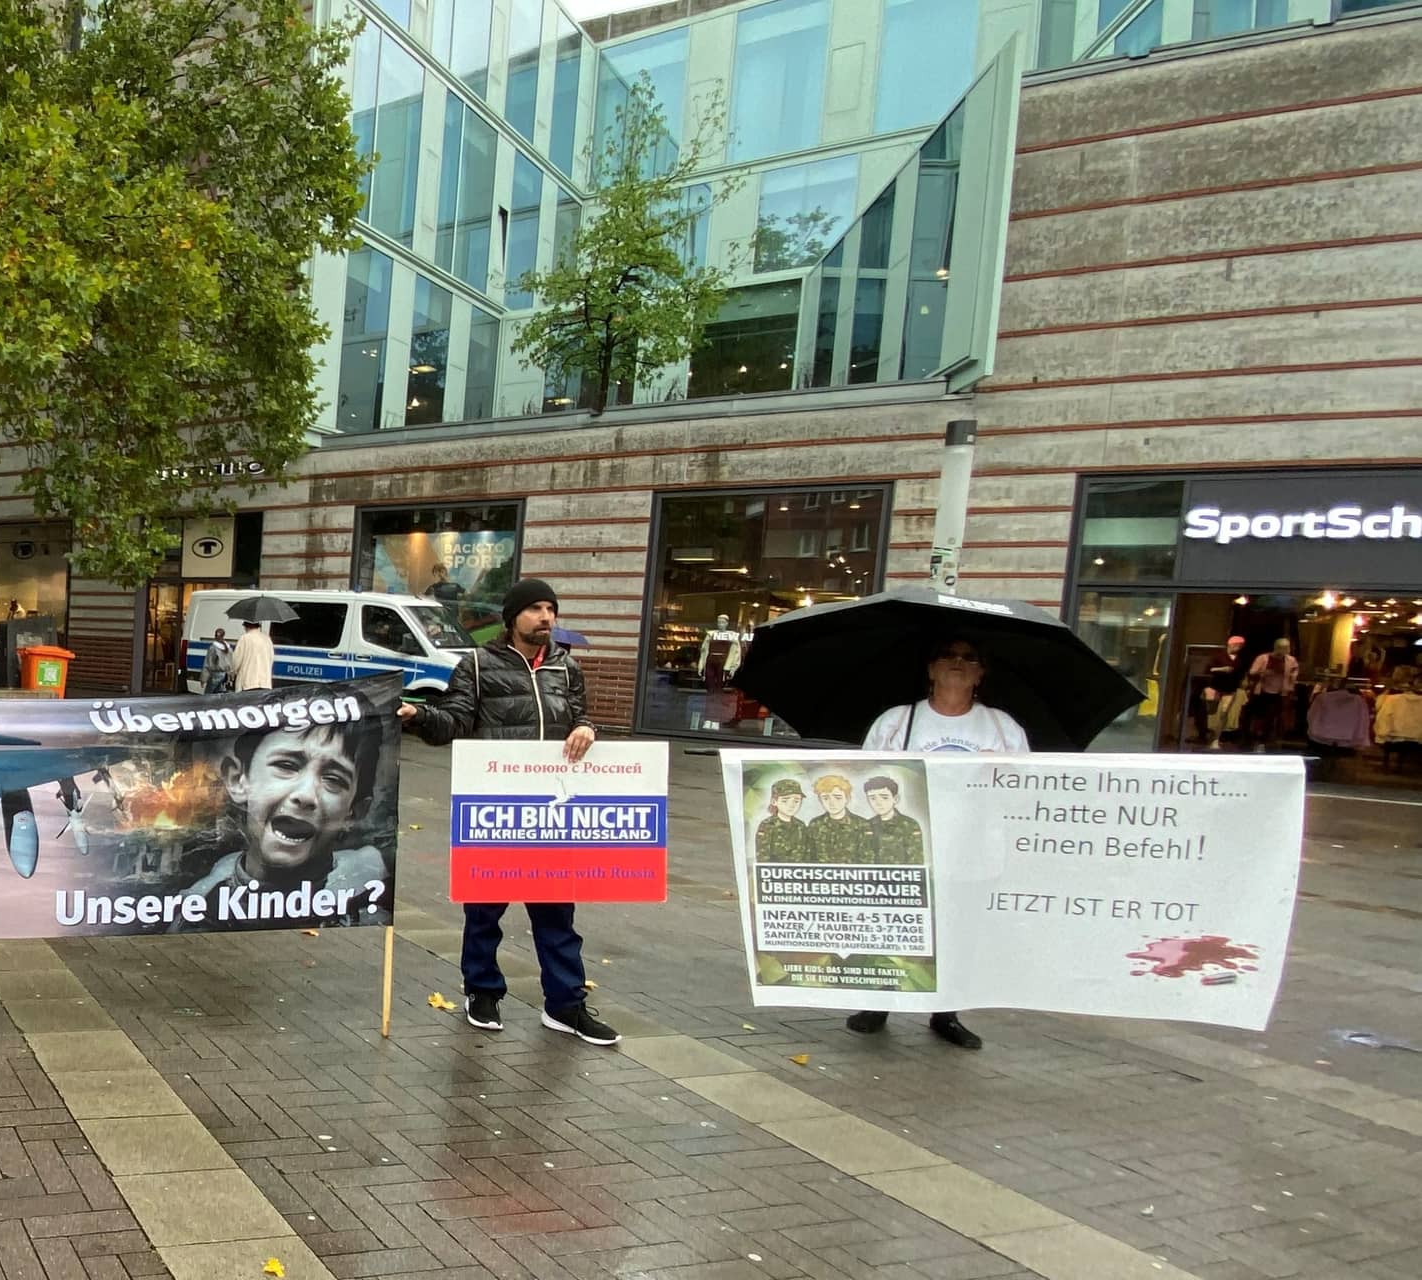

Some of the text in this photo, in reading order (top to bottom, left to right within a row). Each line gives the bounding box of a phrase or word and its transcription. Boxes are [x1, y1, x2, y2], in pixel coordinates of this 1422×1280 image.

[444, 543, 505, 554] BACK TO
[444, 555, 506, 569] SPORT
[287, 665, 323, 676] POLIZEI
[89, 691, 361, 733] Übermorgen
[487, 761, 498, 773] Я
[502, 763, 519, 773] не
[524, 763, 568, 774] воюю
[582, 761, 642, 774] Россией
[1097, 772, 1140, 794] Ihn
[469, 806, 651, 829] ICH BIN NICHT
[1117, 805, 1179, 828] NUR
[469, 829, 651, 840] IM KRIEG MIT RUSSLAND
[1015, 834, 1094, 857] einen
[499, 867, 522, 879] not
[527, 869, 540, 879] at
[545, 871, 570, 879] war
[575, 867, 606, 879] with
[610, 867, 655, 879] Russia
[761, 868, 922, 882] DURCHSCHNITTLICHE
[761, 879, 922, 897] ÜBERLEBENSDAUER
[55, 889, 206, 927] Unsere
[218, 879, 354, 921] Kinder
[804, 896, 893, 905] KONVENTIONELLEN
[894, 898, 922, 906] KRIEG
[986, 892, 1200, 922] JETZT IST ER TOT
[763, 910, 923, 925] INFANTERIE: 4-5 TAGE
[763, 922, 805, 931] PANZER
[817, 923, 874, 933] HAUBITZE:
[876, 925, 894, 933] 3-7
[895, 925, 924, 934] TAGE
[895, 935, 925, 944] TAGE
[826, 966, 841, 974] DAS
[842, 967, 861, 975] SIND
